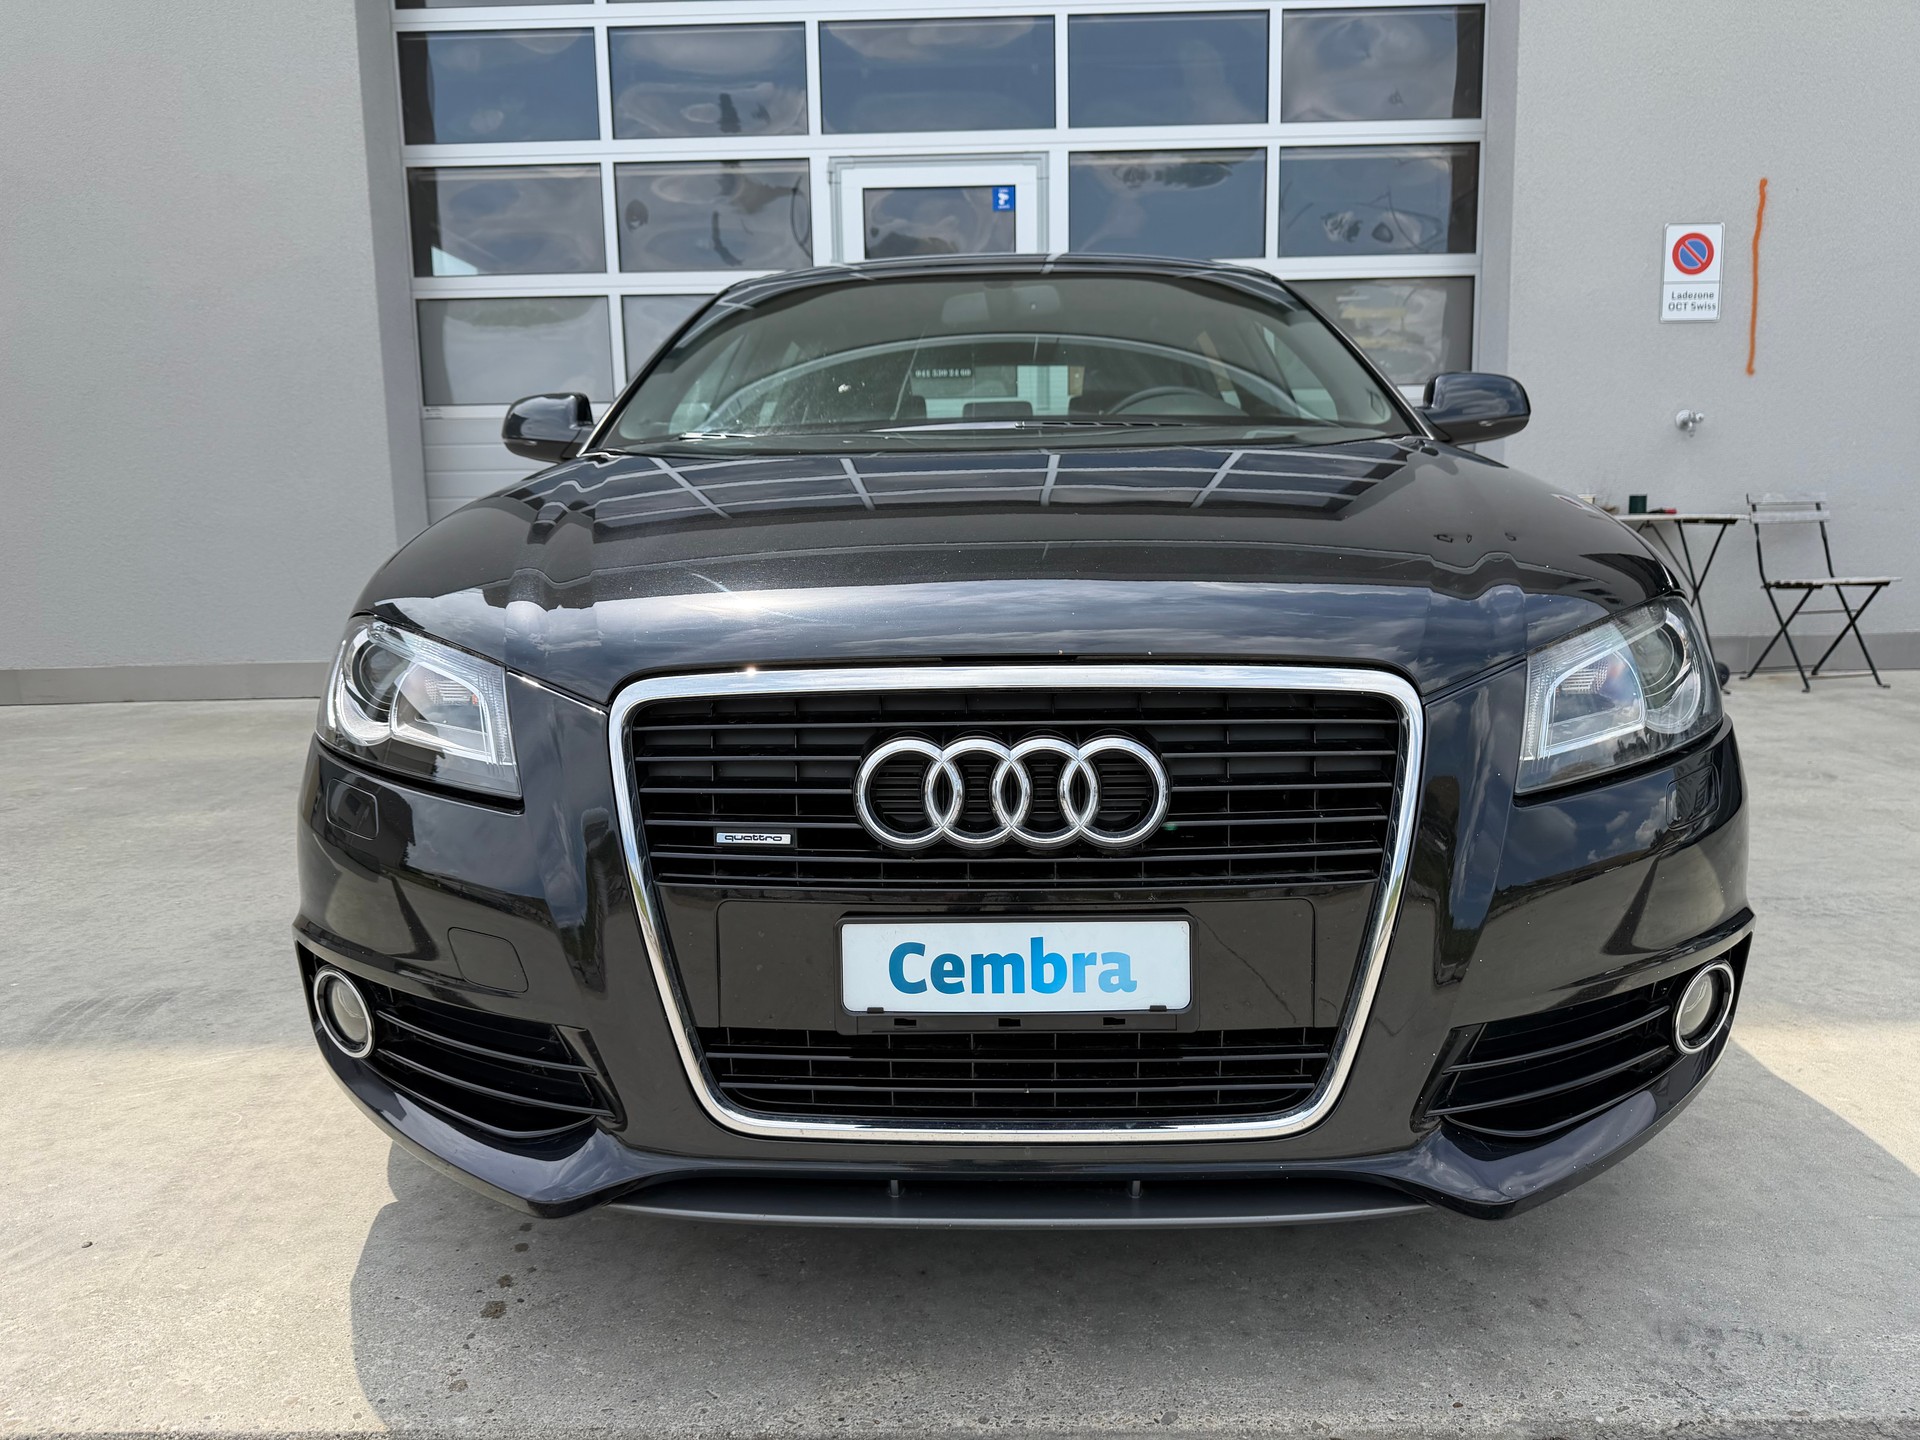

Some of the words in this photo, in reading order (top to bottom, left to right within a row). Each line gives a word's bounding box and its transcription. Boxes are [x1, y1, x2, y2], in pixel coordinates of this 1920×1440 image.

[1671, 291, 1715, 300] Ladezone
[1668, 302, 1688, 312] OCT
[1690, 301, 1717, 311] Swiss
[724, 834, 783, 842] quattro
[888, 936, 1138, 995] Cembra
